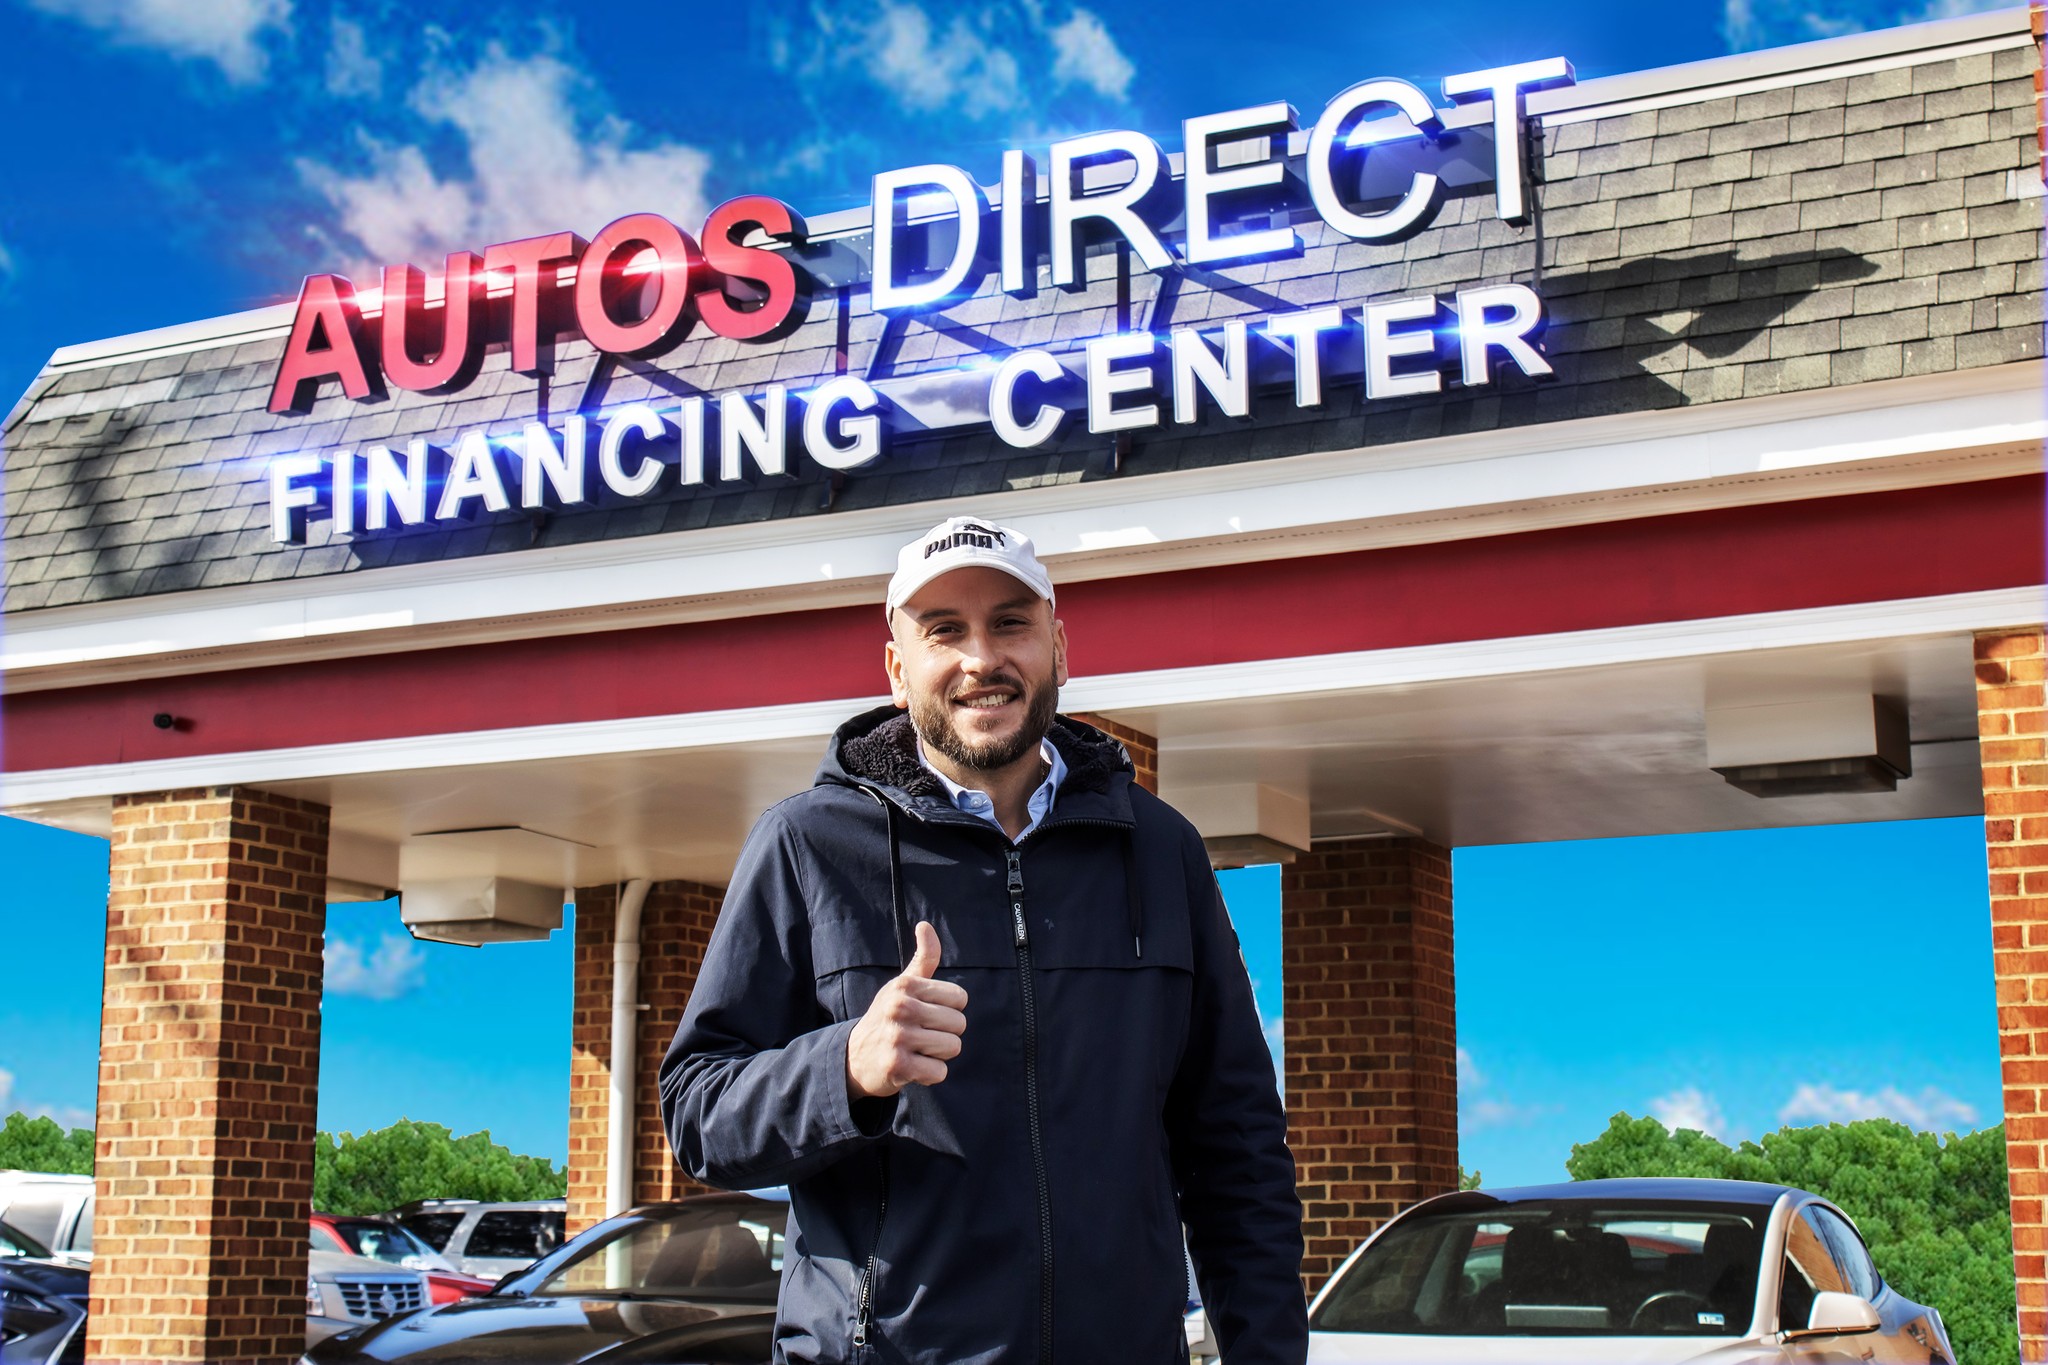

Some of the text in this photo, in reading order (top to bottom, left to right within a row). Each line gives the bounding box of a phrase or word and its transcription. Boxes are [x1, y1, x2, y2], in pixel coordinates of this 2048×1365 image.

[267, 56, 1573, 413] AUTOS DIRECT
[270, 284, 1553, 542] FINANCING CENTER
[924, 532, 992, 559] PUMA
[1014, 902, 1025, 940] CALVIN KLEIN
